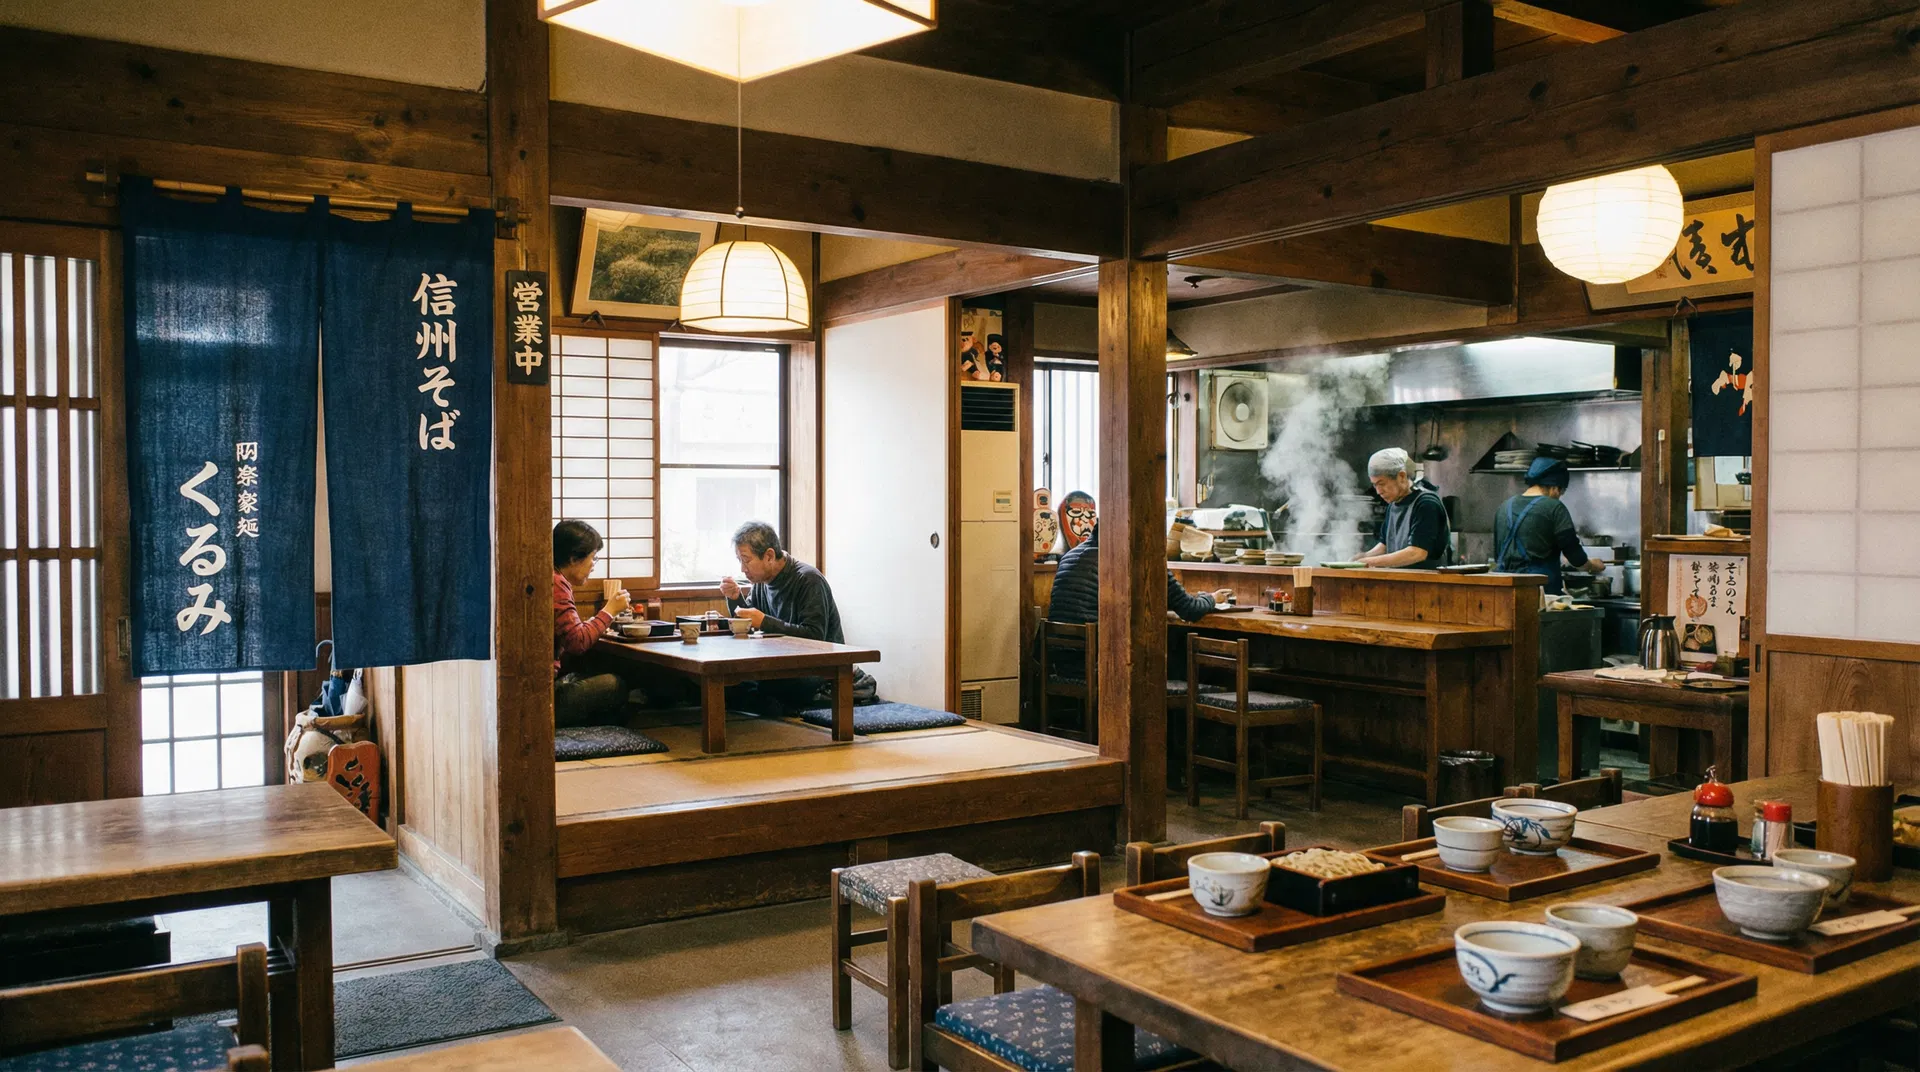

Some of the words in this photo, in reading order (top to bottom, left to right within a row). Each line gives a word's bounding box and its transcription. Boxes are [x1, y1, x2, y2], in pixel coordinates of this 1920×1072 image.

[413, 273, 460, 449] 信州そば
[513, 282, 543, 375] 営業中
[177, 461, 232, 635] くるみ
